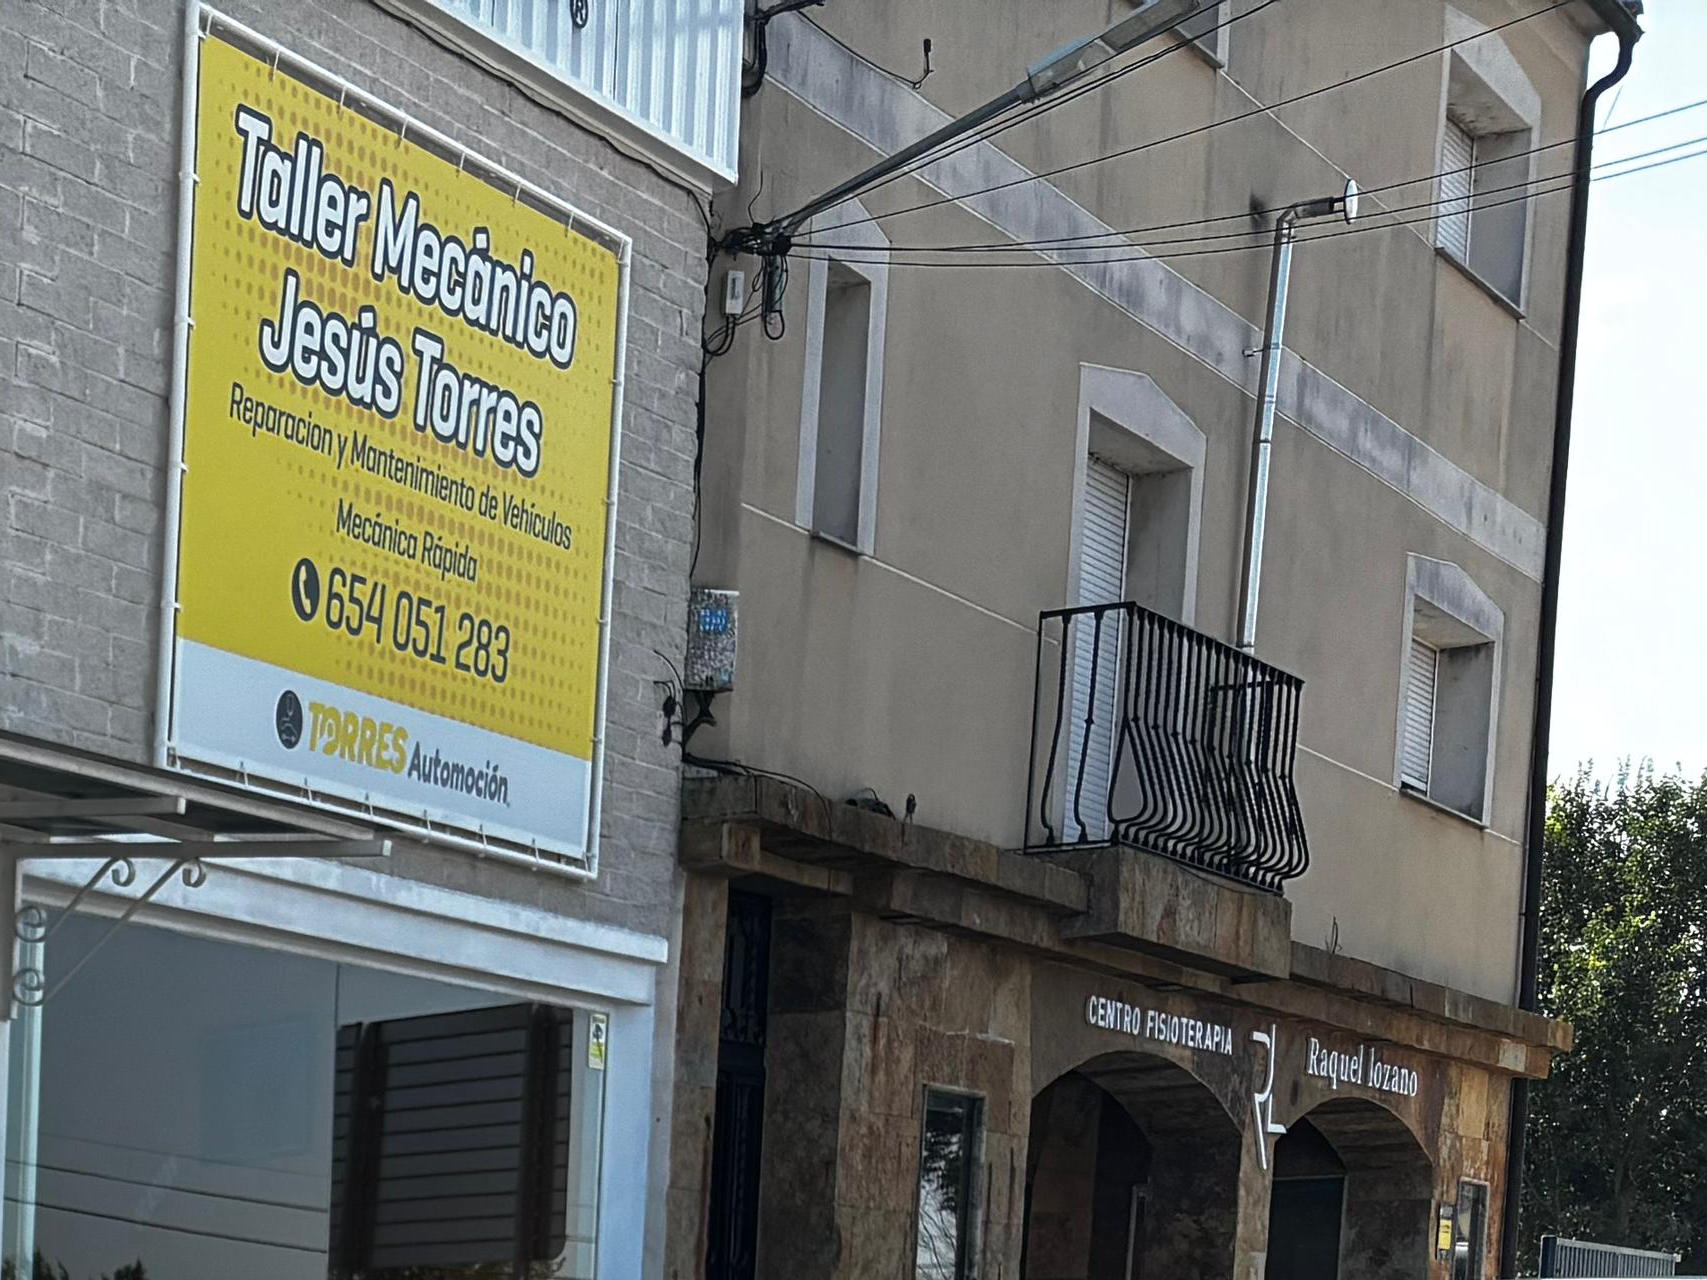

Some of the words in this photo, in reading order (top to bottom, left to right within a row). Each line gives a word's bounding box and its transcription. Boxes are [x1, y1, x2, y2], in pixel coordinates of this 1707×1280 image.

[236, 102, 370, 265] Taller
[373, 178, 578, 369] Mecánico
[259, 269, 404, 419] Jesús
[413, 328, 542, 477] Torres
[230, 382, 333, 456] Reparacion
[337, 434, 347, 469] y
[351, 432, 474, 516] Mantenimiento
[478, 485, 499, 520] de
[502, 492, 573, 550] Vehículos
[336, 498, 417, 562] Mecánica
[420, 530, 477, 583] Rápida
[325, 566, 386, 645] 654
[392, 590, 447, 665] 051
[454, 611, 511, 685] 283
[307, 701, 407, 775] TORRES
[1089, 996, 1141, 1035] CENTRO
[1146, 1010, 1233, 1056] FISIOTERAPIA
[1308, 1037, 1364, 1089] Raquel
